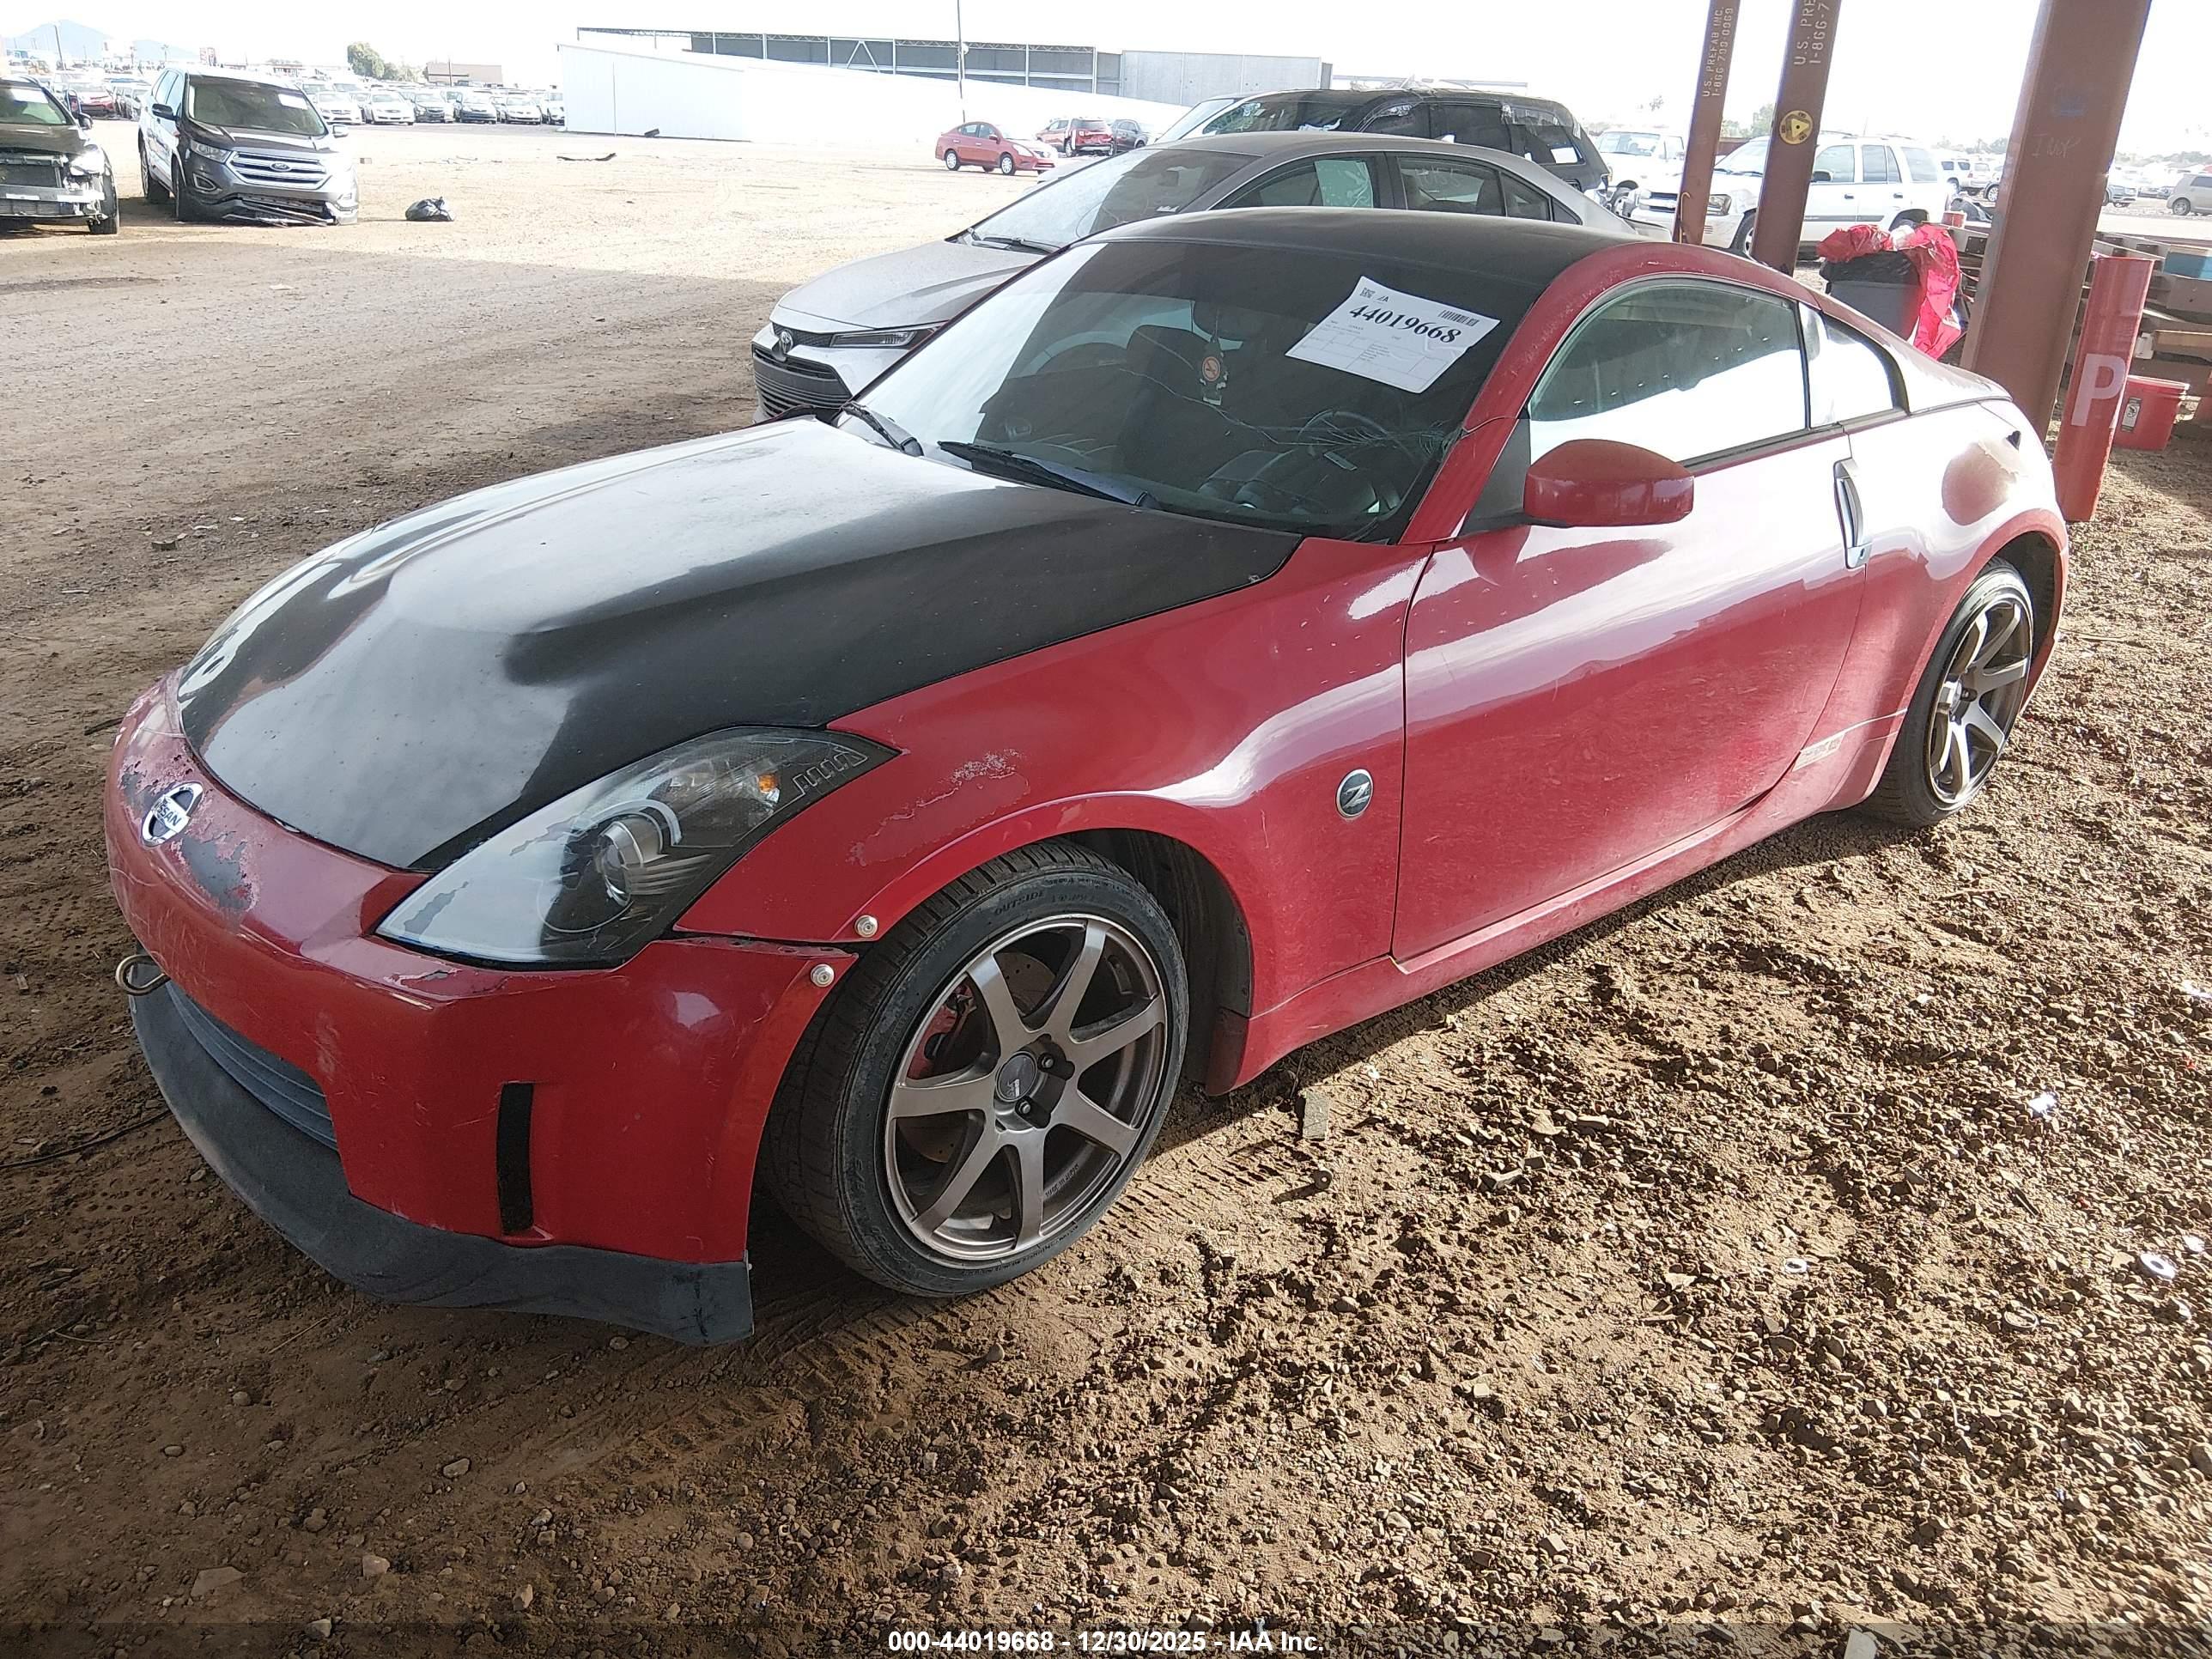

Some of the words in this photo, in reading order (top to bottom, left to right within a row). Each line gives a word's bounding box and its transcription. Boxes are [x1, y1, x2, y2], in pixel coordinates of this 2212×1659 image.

[1713, 7, 1724, 27] INC.
[1706, 32, 1719, 72] PREFAB
[1794, 36, 1810, 65] U.S.
[1702, 77, 1713, 97] U.S.
[1349, 305, 1462, 343] 44019668
[2070, 353, 2126, 427] P
